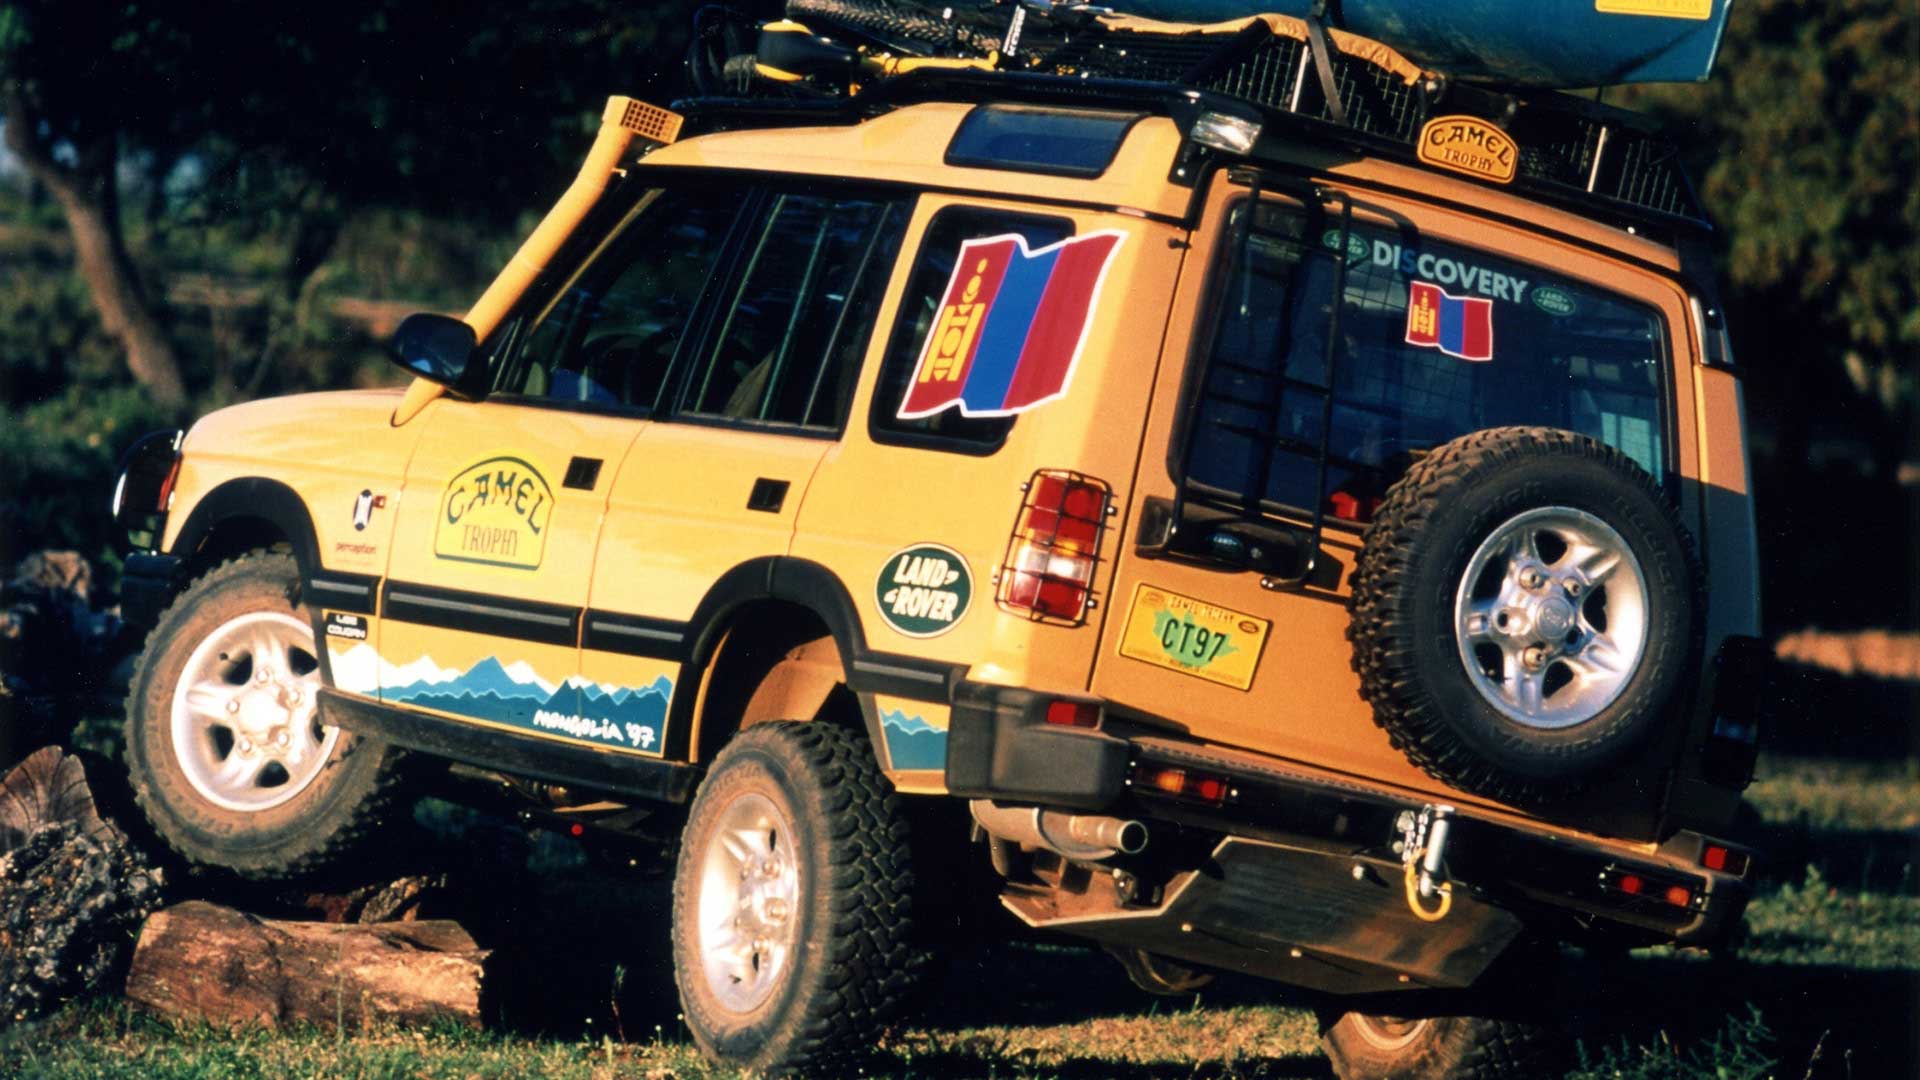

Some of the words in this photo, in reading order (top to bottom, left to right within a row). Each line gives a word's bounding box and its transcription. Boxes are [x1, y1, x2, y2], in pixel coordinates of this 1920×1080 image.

[1430, 126, 1510, 167] CAMEL
[1444, 147, 1495, 171] TROPHY
[1373, 240, 1528, 303] DISCOVERY
[447, 470, 542, 535] CAMEL
[893, 554, 951, 588] LAND
[889, 585, 959, 622] ROVER
[1162, 618, 1226, 662] CT97
